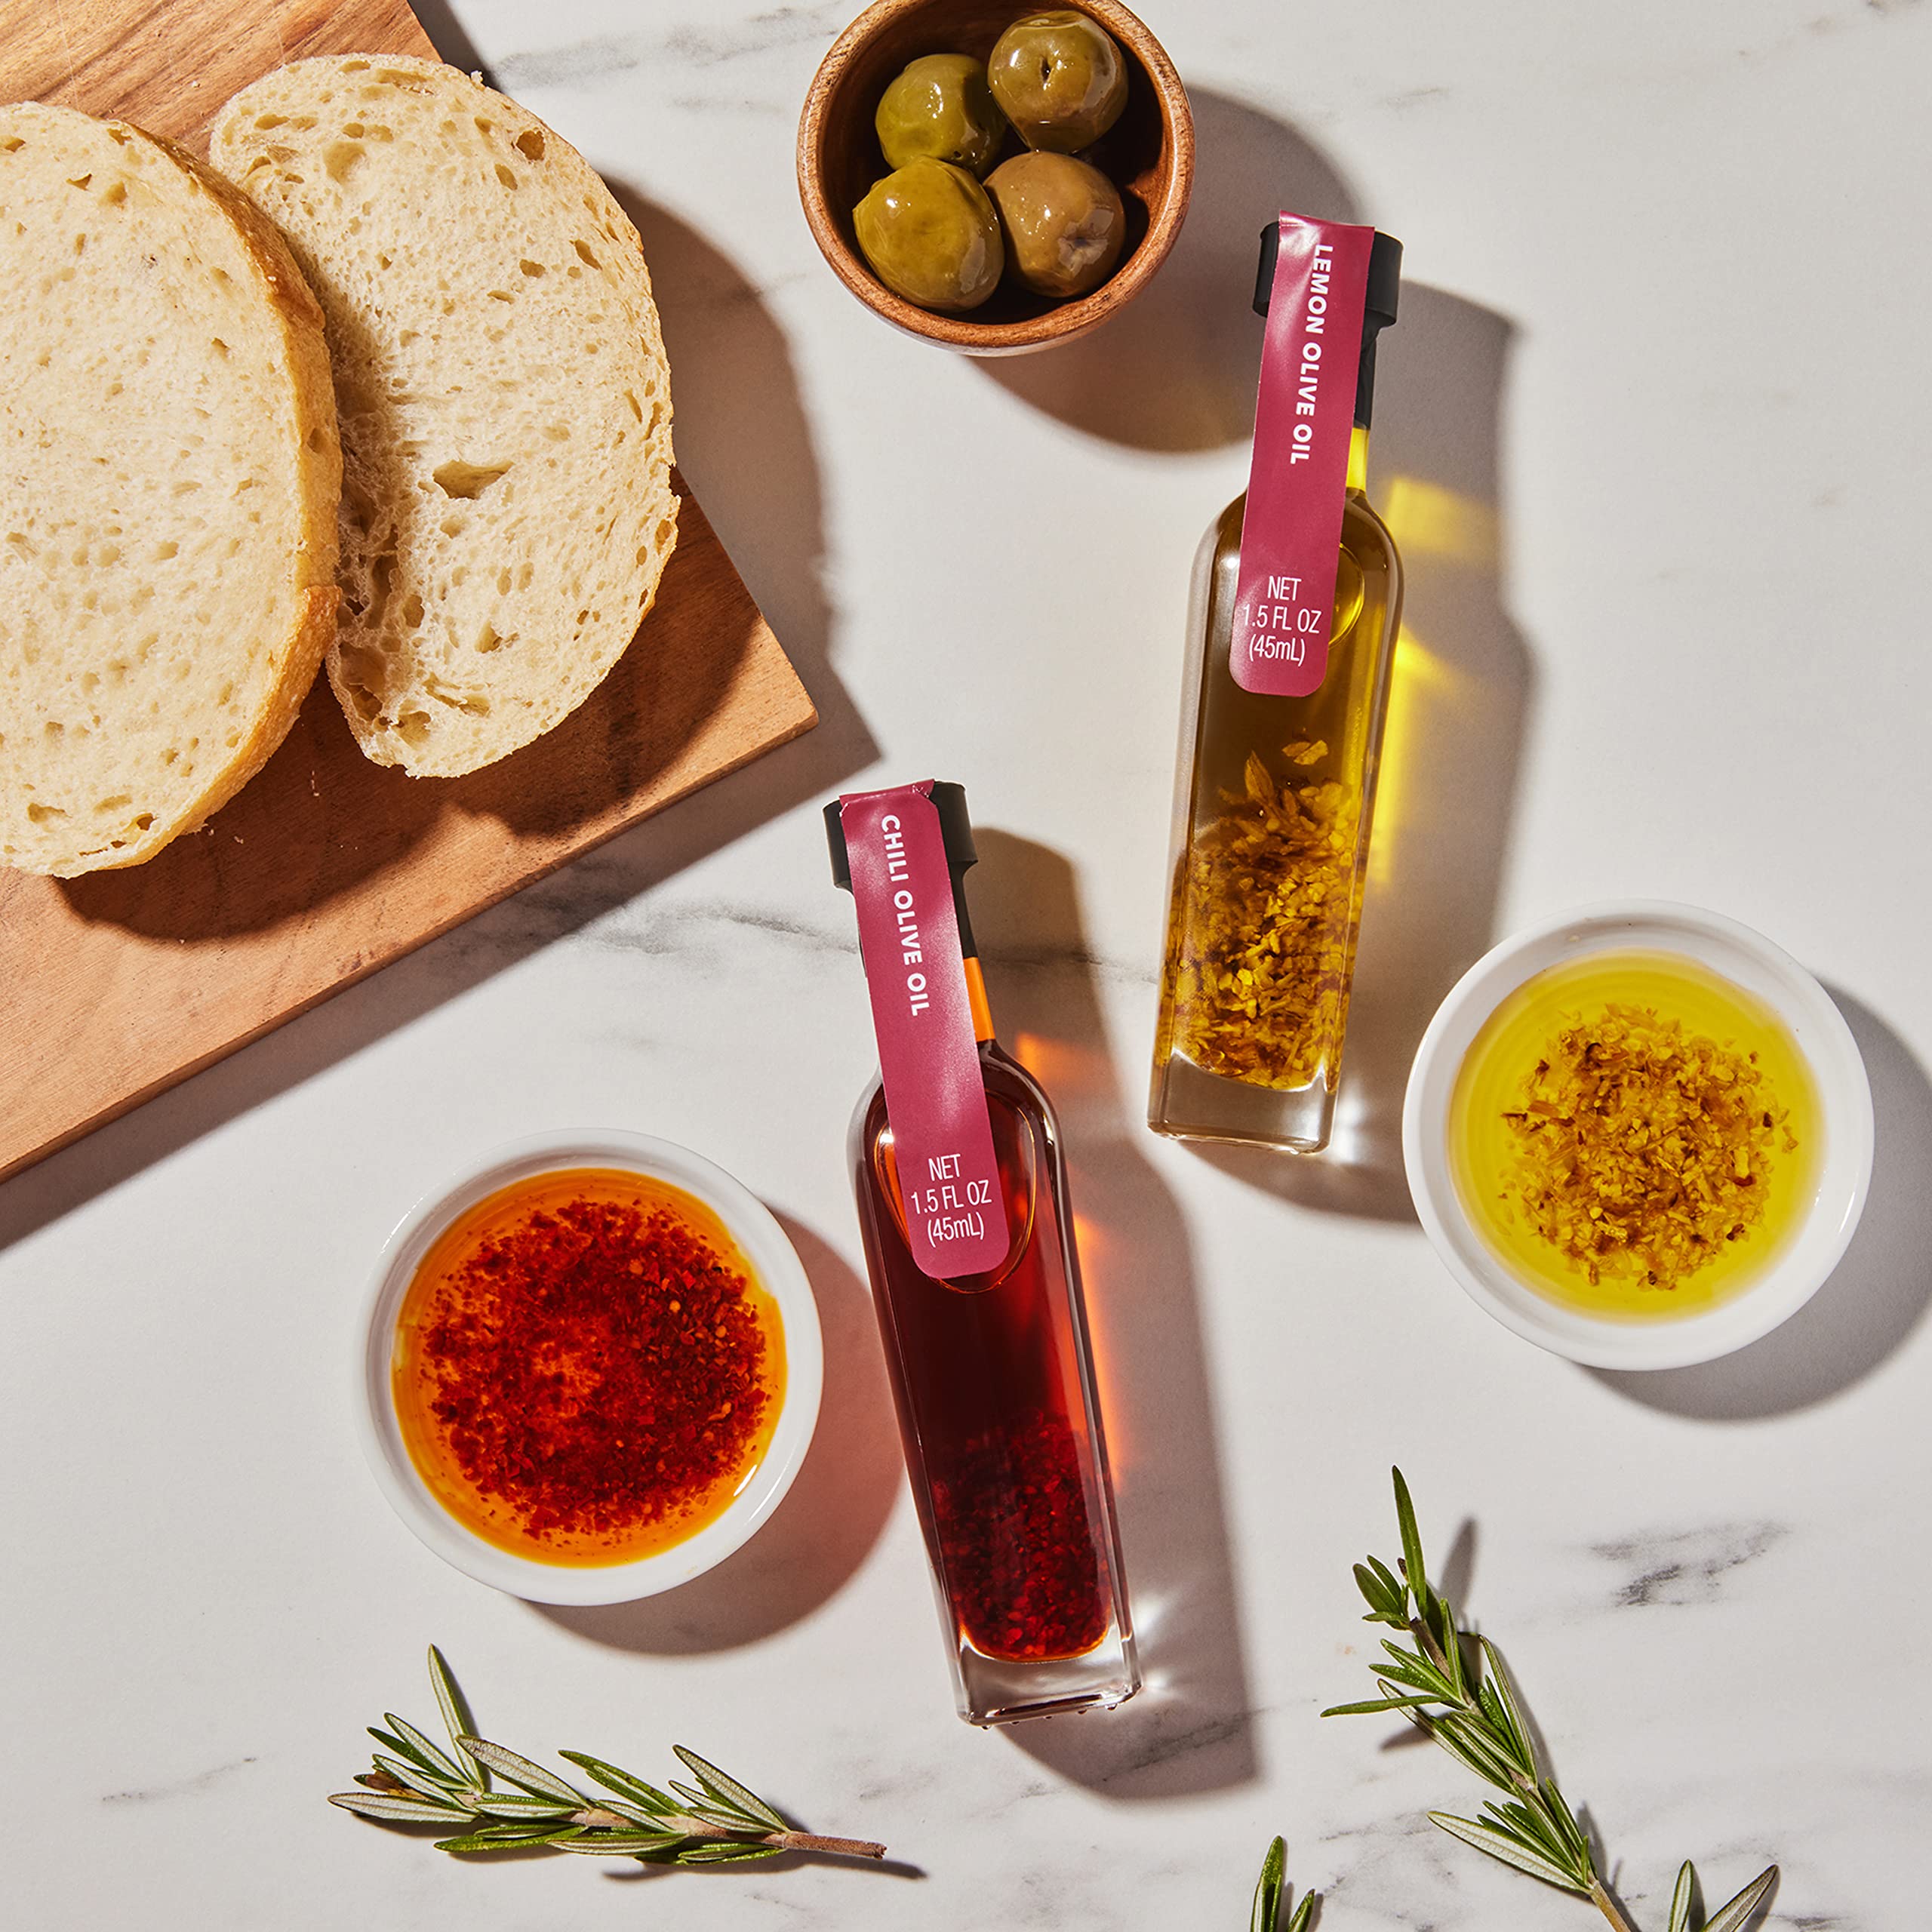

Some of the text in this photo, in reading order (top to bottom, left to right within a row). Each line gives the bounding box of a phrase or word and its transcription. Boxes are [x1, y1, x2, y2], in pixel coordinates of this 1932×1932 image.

[1290, 244, 1334, 465] LEMON OLIVE OIL
[1267, 575, 1302, 601] NET
[1243, 603, 1322, 634] 1.5 FL OZ
[1249, 633, 1306, 667] (45mL)
[881, 814, 930, 1017] CHILI OLIVE OIL
[928, 1153, 961, 1182] NET
[910, 1179, 992, 1214] 1.5 FL OZ
[927, 1211, 984, 1248] (45mL)
